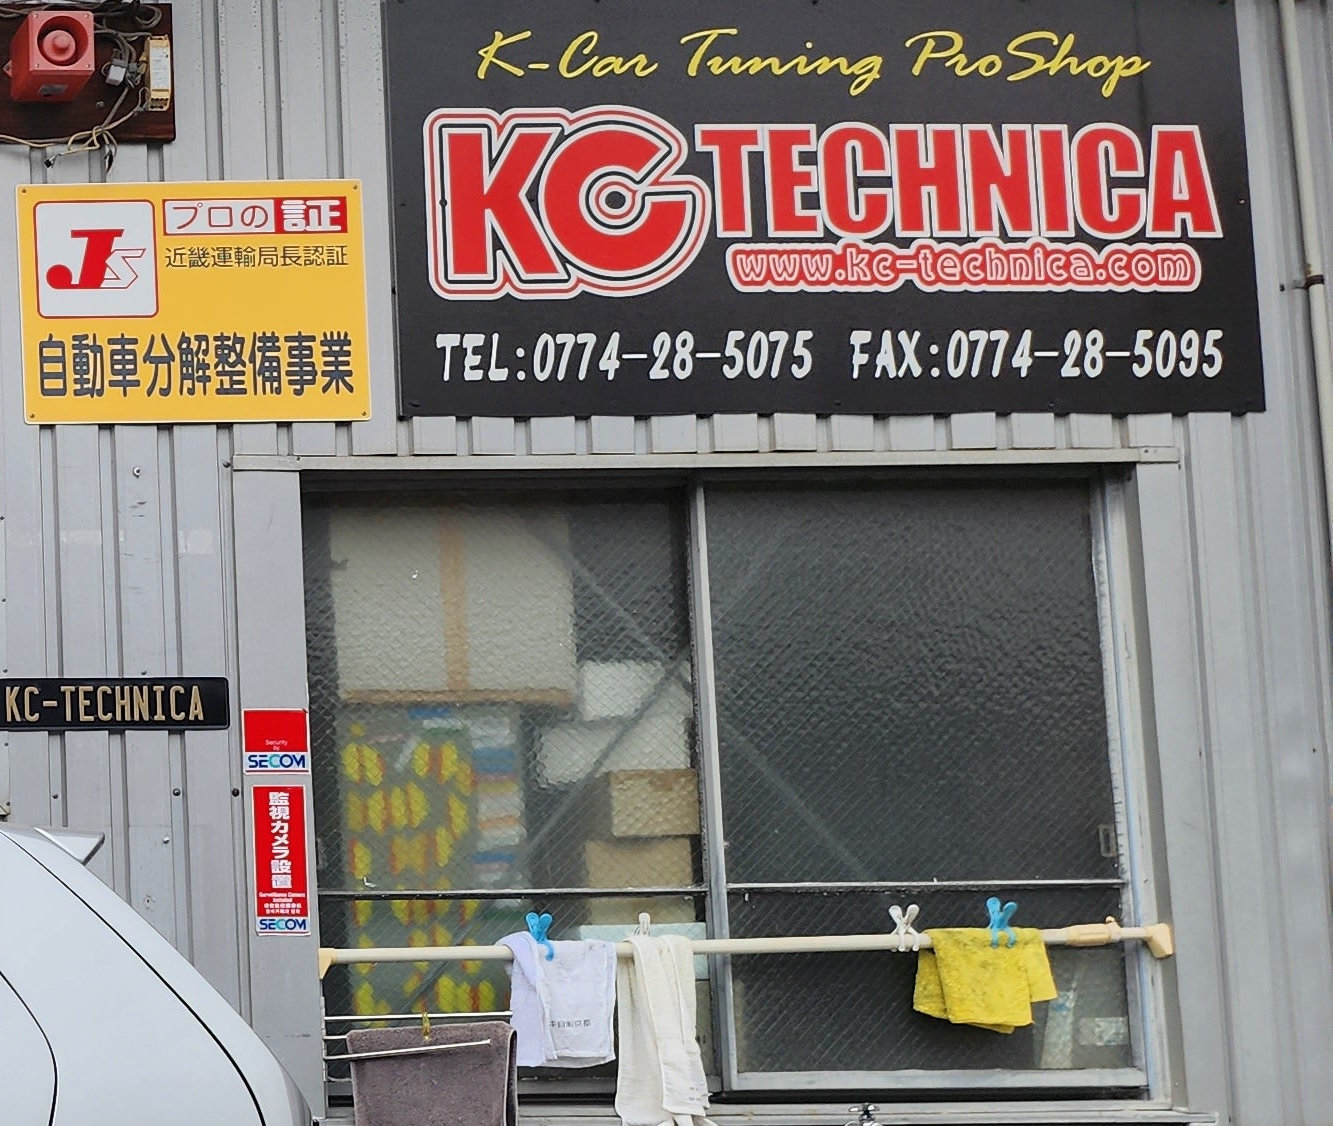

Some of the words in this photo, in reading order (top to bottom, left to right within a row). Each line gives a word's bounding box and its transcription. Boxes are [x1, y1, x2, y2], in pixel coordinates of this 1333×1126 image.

[476, 28, 658, 82] K-Car
[679, 27, 885, 97] Tuning
[428, 109, 708, 298] KC
[695, 121, 1223, 241] TECHNICA
[164, 244, 349, 270] 近畿運輸局長認証
[735, 244, 1193, 288] www.kc-technica.com
[38, 331, 354, 398] 自動車分解整備事業
[435, 330, 814, 384] TEL:0774-28-5075
[849, 328, 1225, 382] FAX:0774-28-5095
[5, 684, 204, 724] KC-TECHNICA
[247, 754, 306, 769] SECOM
[268, 791, 293, 889] 監視カメラ設置
[259, 918, 307, 931] SECOM
